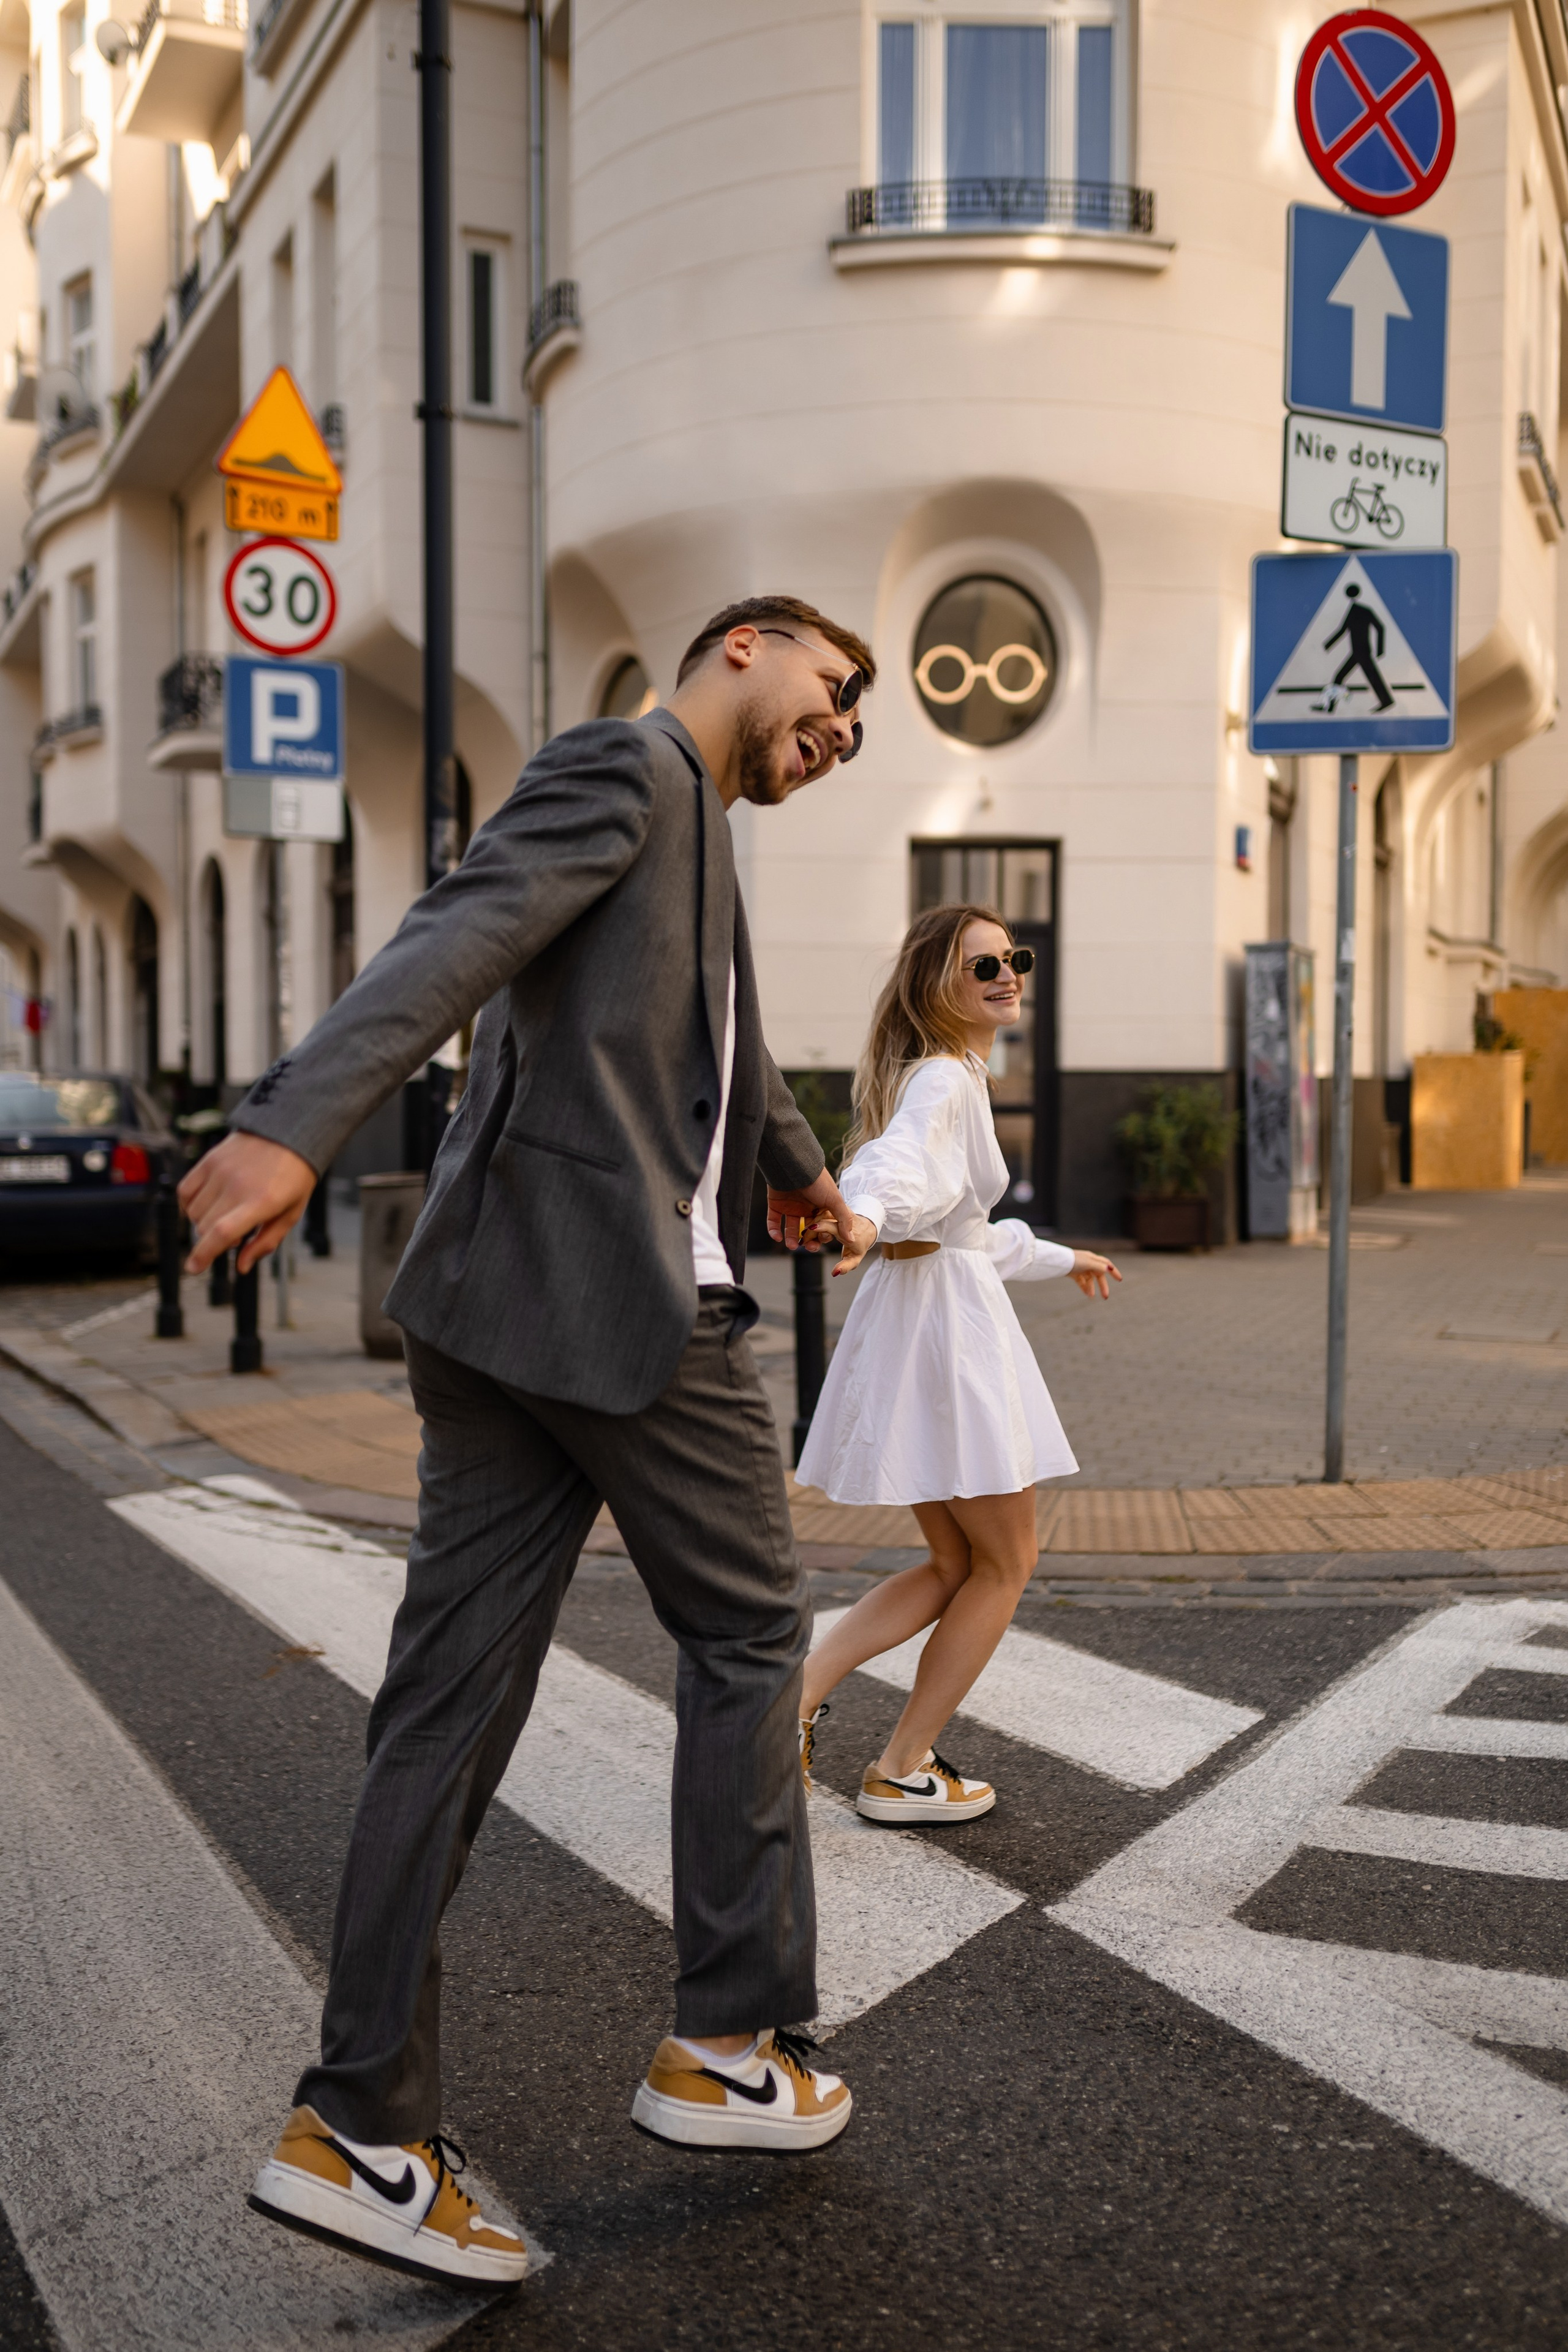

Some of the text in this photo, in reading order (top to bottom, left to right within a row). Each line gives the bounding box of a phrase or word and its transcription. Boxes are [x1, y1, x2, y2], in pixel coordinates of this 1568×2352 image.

[1294, 430, 1440, 486] Nie dotyczy
[246, 494, 320, 526] 210 m
[242, 564, 320, 626] 30
[251, 668, 321, 764] P
